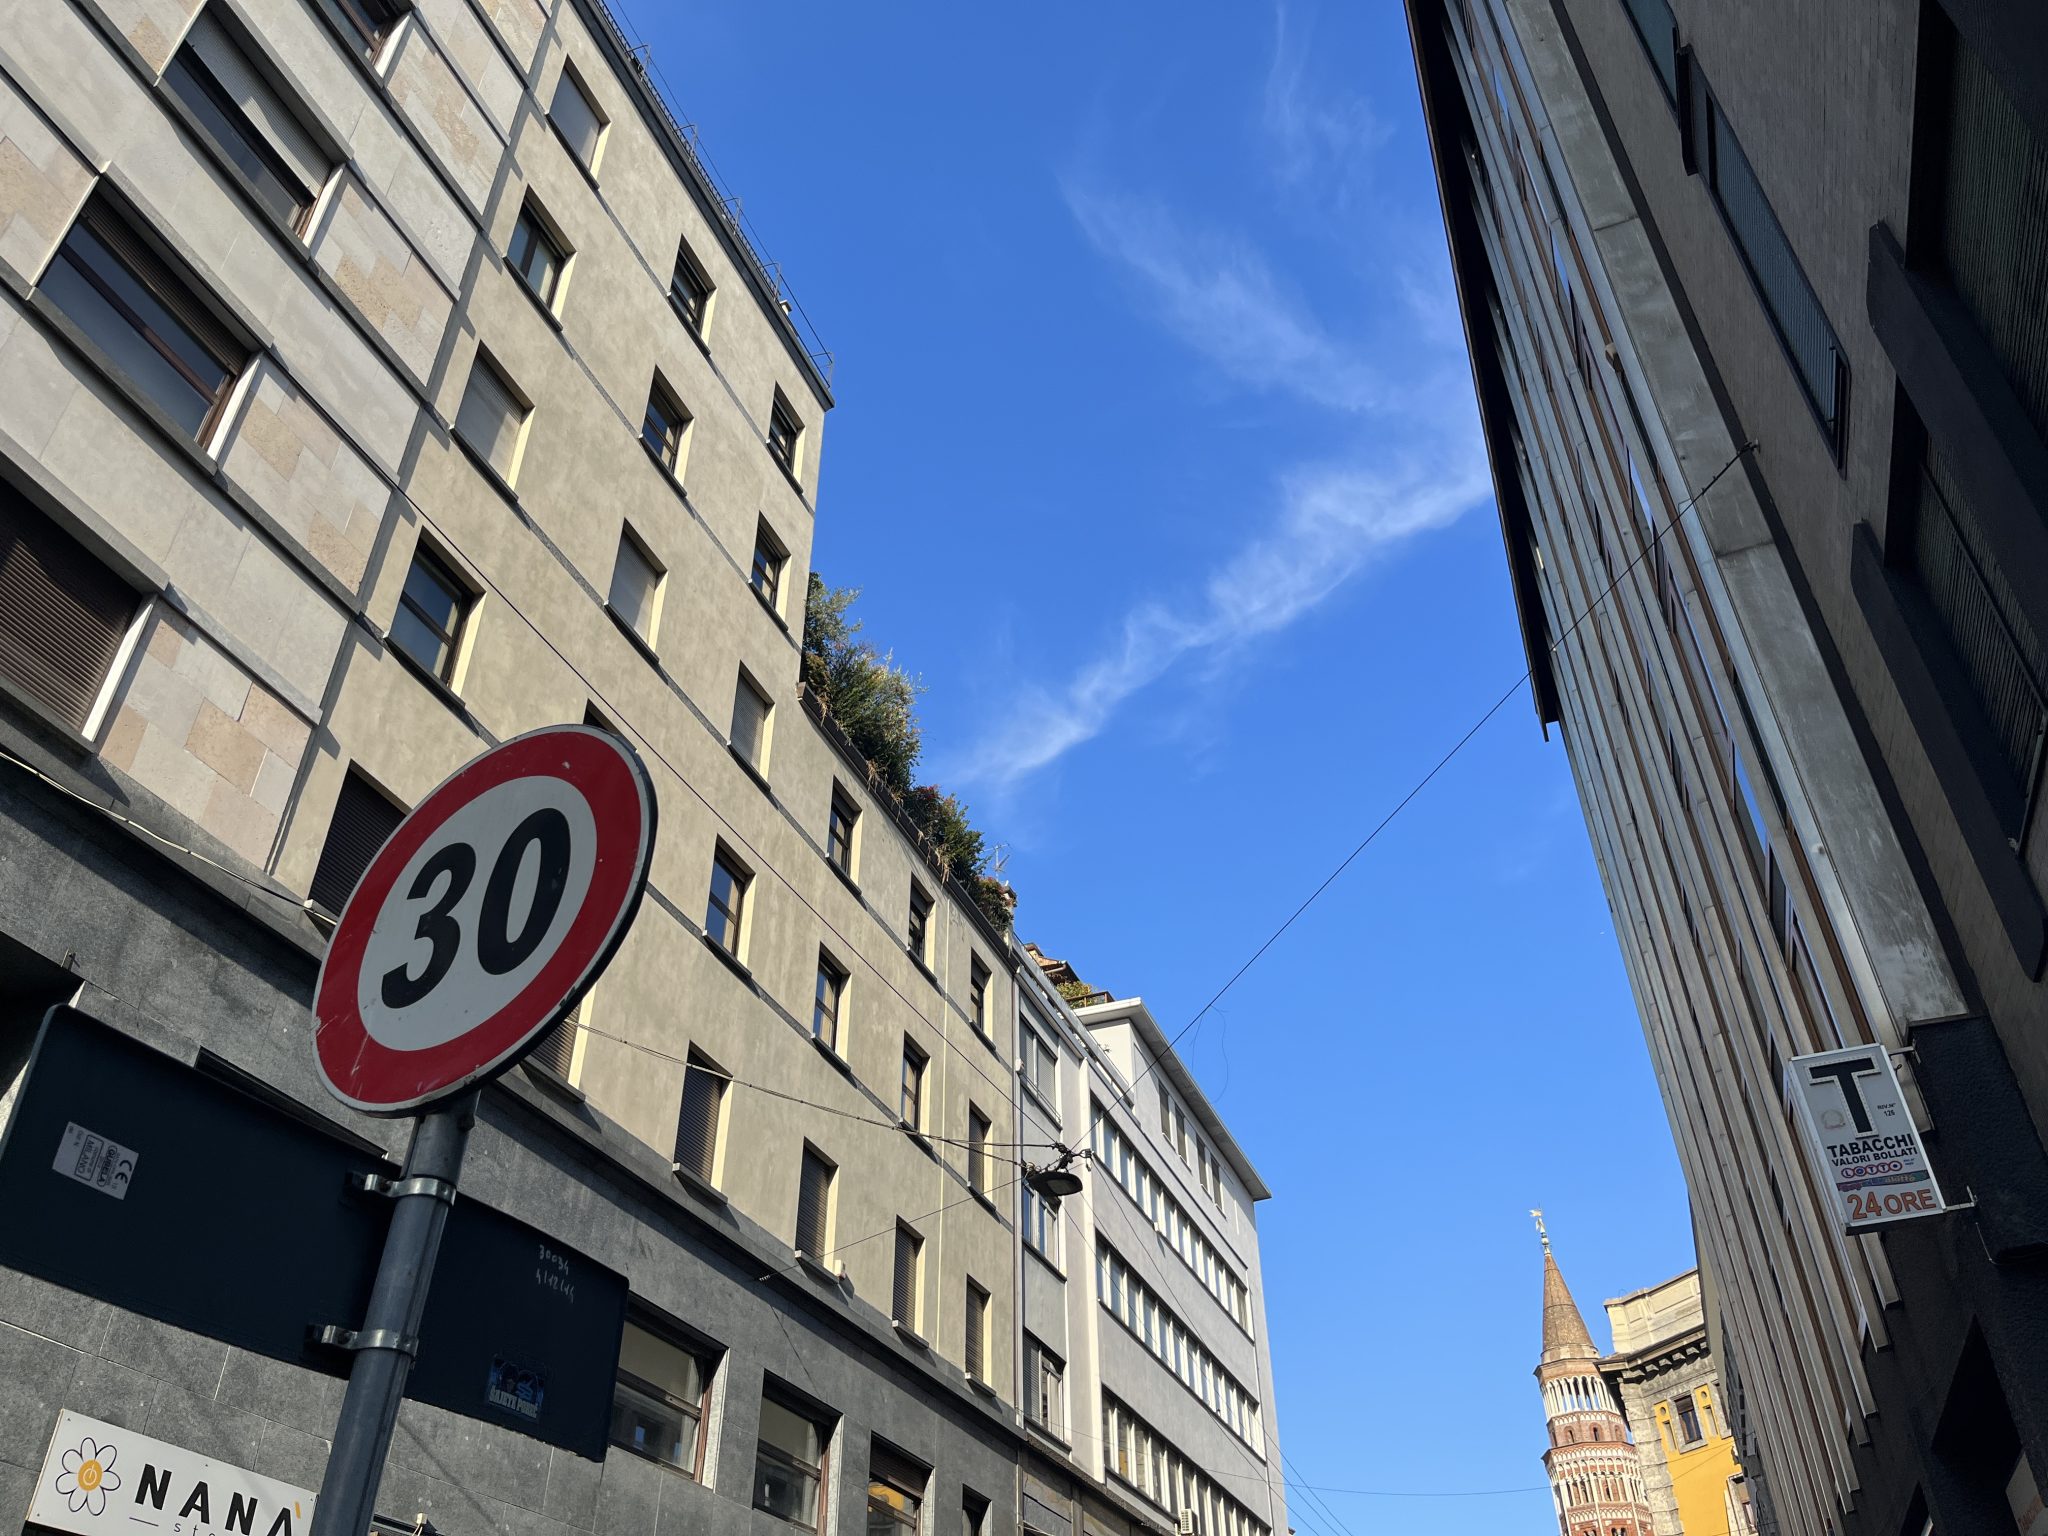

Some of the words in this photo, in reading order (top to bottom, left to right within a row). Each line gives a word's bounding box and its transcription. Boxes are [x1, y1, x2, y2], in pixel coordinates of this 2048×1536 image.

[381, 807, 571, 1009] 30
[1804, 1056, 1881, 1138] T
[1827, 1133, 1915, 1158] TABACCHI
[1832, 1154, 1871, 1167] VALORI
[1874, 1147, 1918, 1161] BOLLATI
[1847, 1191, 1882, 1220] 24
[1884, 1188, 1937, 1214] ORE
